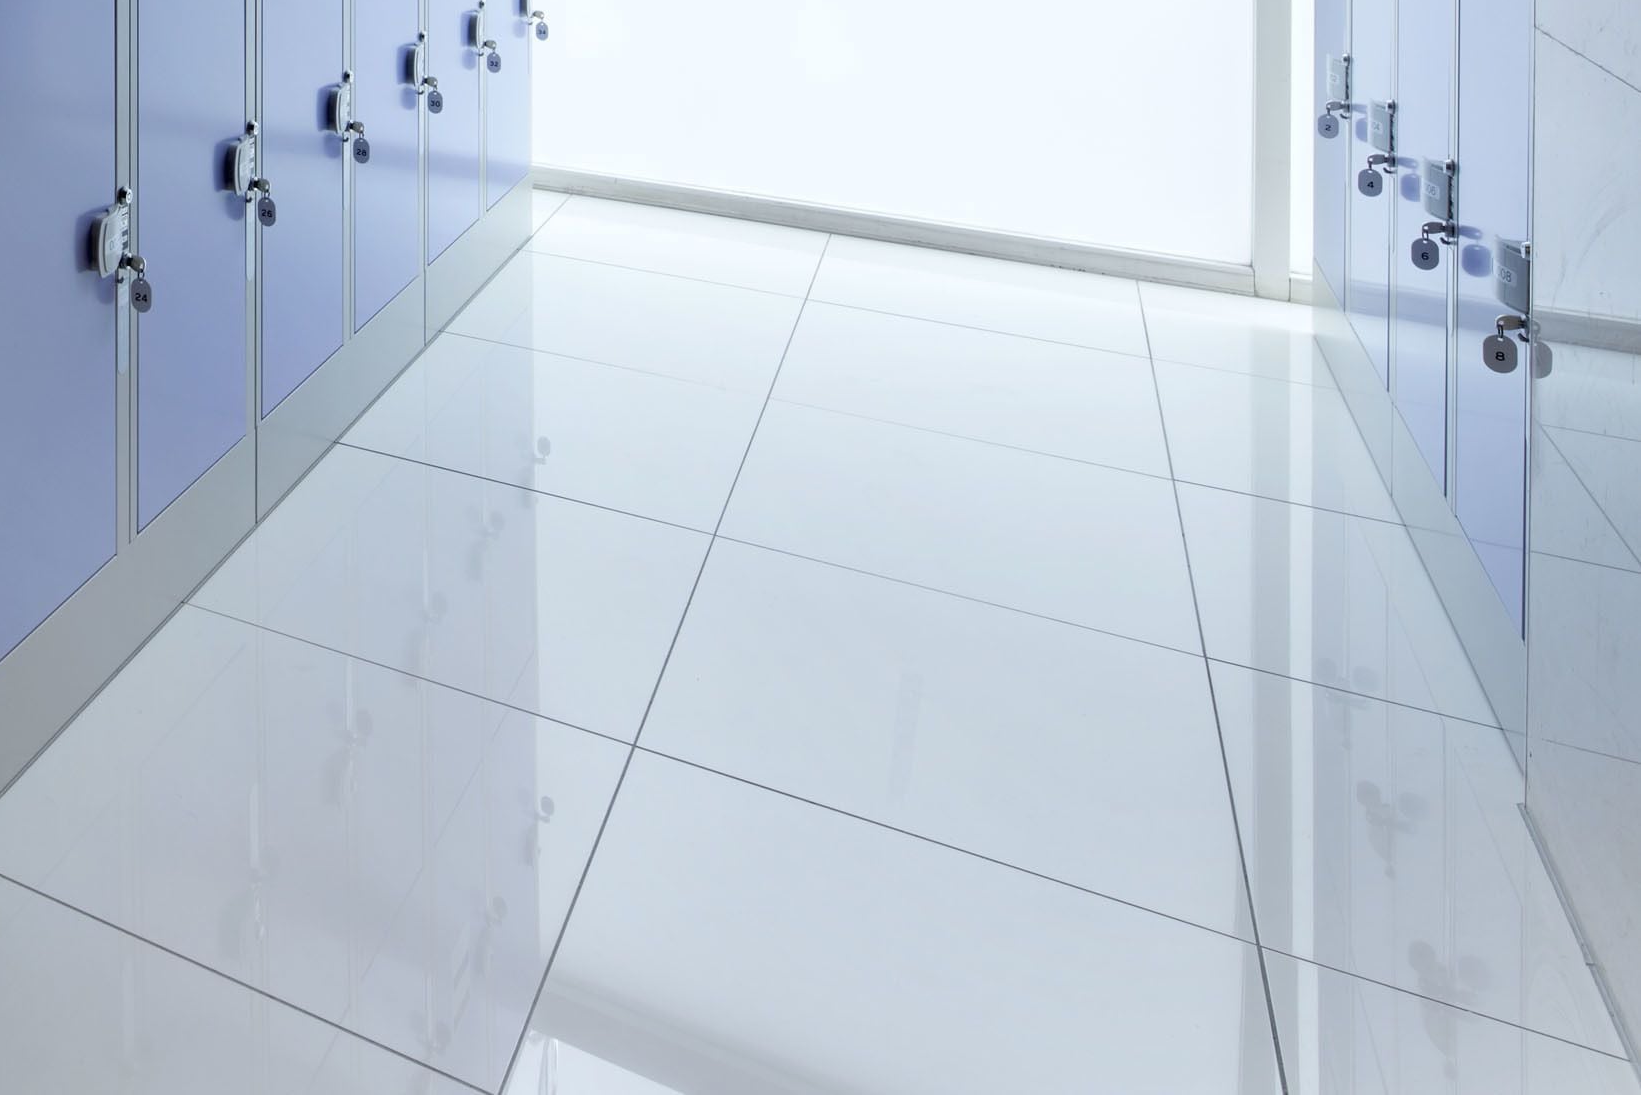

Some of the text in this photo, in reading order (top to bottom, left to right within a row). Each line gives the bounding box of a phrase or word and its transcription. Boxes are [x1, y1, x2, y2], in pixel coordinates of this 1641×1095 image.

[261, 209, 272, 218] 26
[1421, 252, 1430, 260] 6
[135, 292, 147, 302] 24
[1495, 351, 1505, 362] 8
